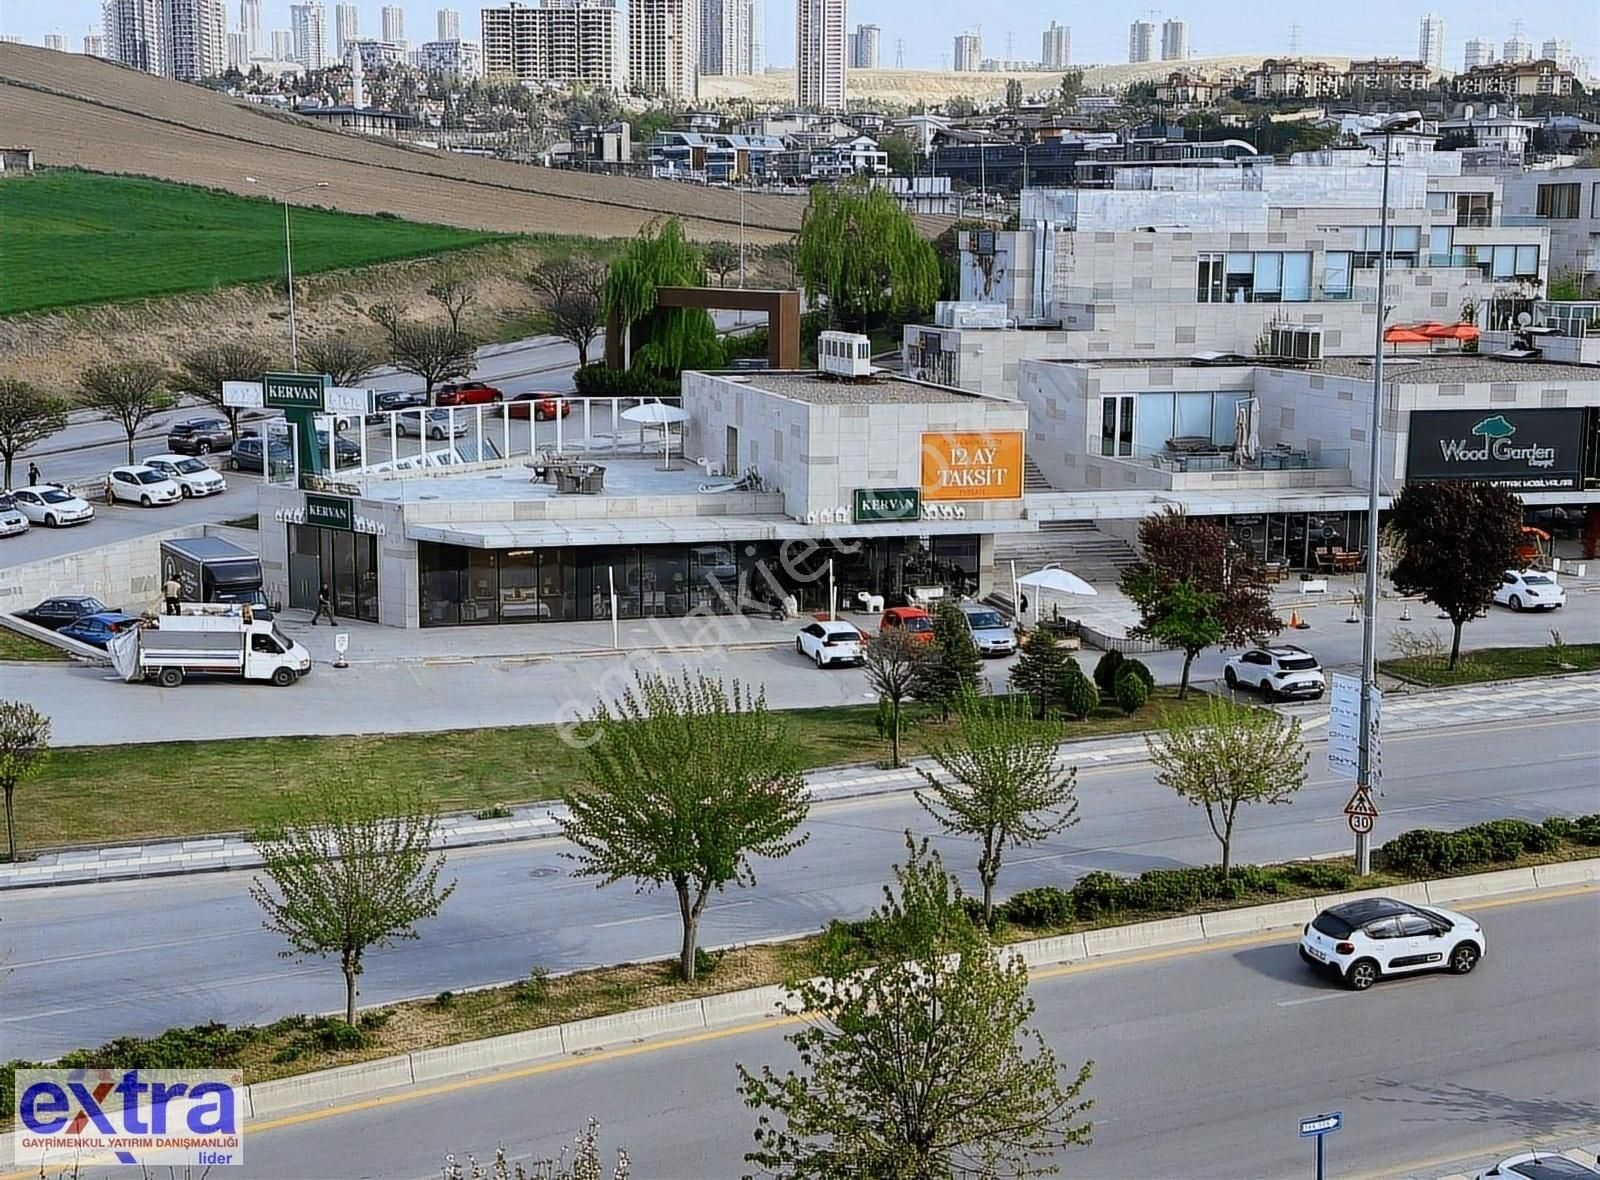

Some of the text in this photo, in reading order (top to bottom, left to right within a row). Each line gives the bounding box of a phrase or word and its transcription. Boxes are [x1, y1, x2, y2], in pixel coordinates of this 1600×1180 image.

[268, 385, 318, 400] KERVAN
[1439, 433, 1555, 461] Wood Garden
[951, 447, 997, 466] 12 AY
[937, 466, 1008, 487] TAKSİT
[309, 504, 347, 519] KERVAN
[862, 498, 915, 511] KERVAN
[1354, 816, 1369, 828] 30
